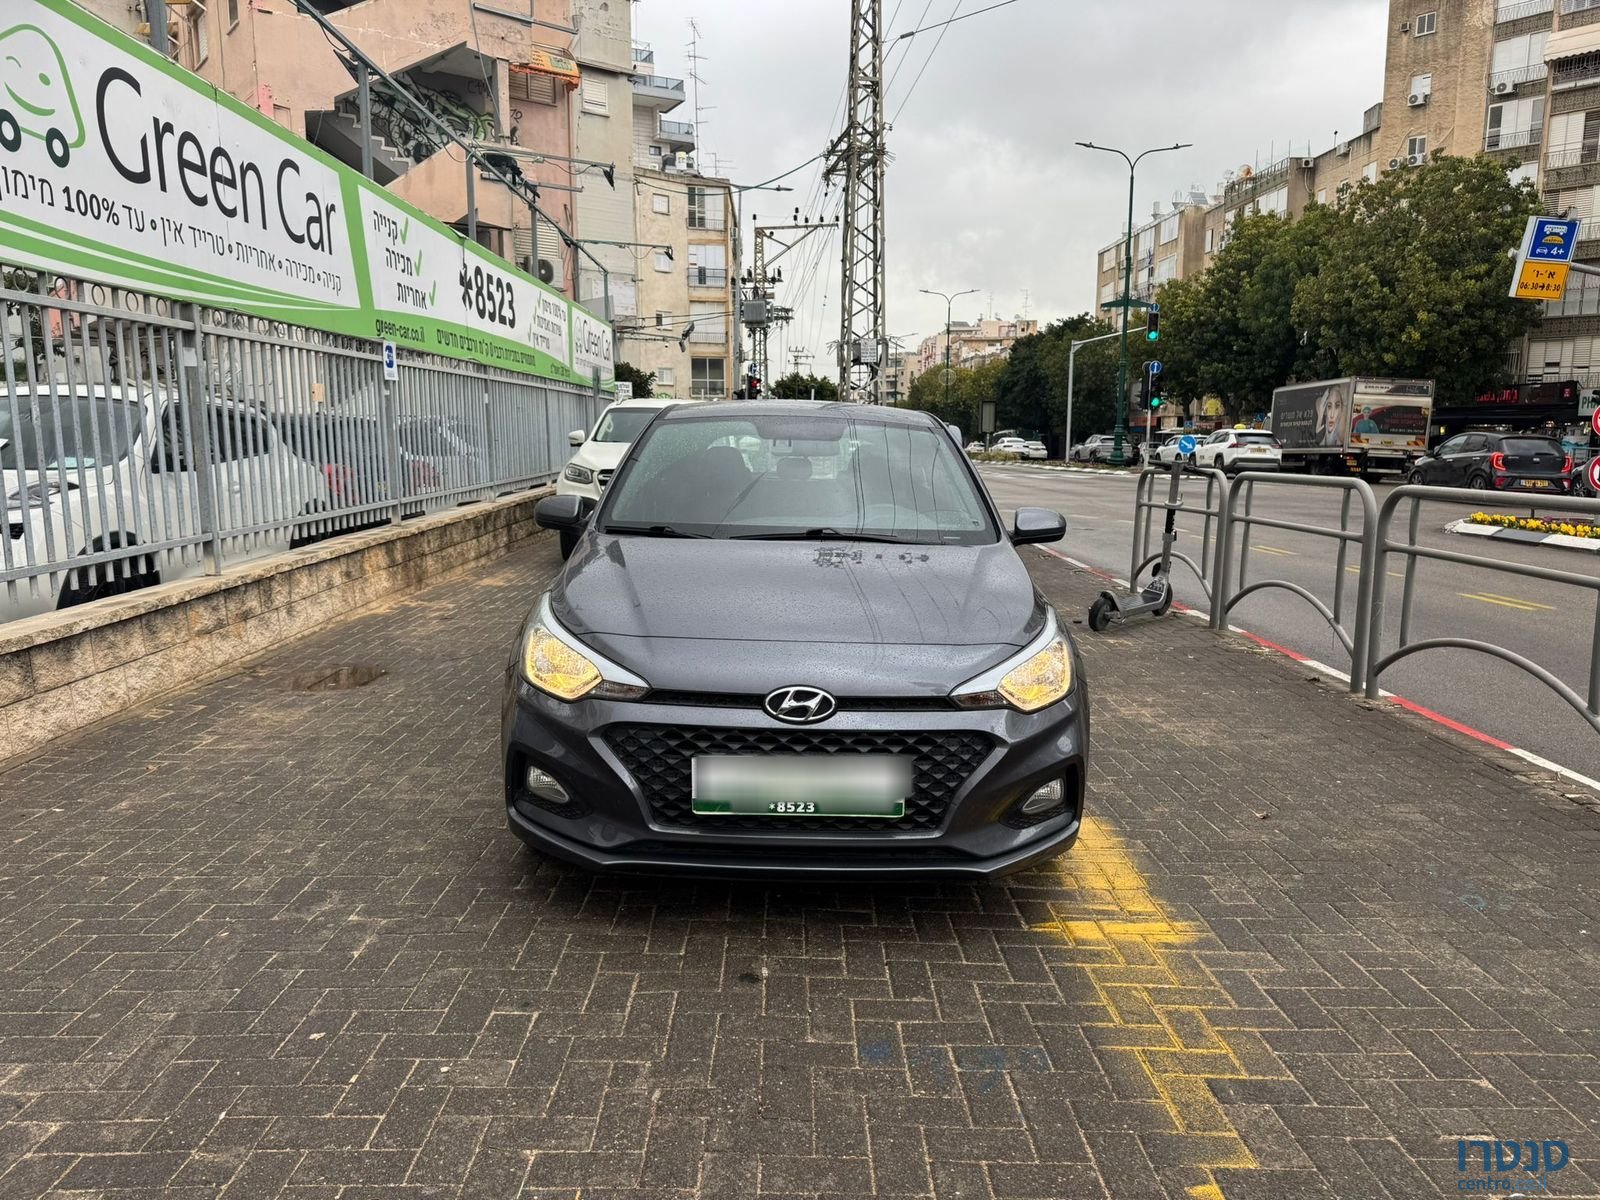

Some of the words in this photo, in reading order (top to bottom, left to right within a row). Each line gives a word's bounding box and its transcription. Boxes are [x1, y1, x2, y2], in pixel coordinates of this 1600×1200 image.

[96, 66, 268, 231] Green
[276, 157, 336, 256] Car
[0, 165, 55, 208] מימו
[62, 185, 120, 226] 100%
[122, 204, 145, 233] עד
[160, 217, 185, 247] אין
[188, 225, 225, 256] טרייד
[373, 210, 398, 245] קנייה
[236, 241, 277, 272] אחריות
[385, 247, 413, 277] מכירה
[1550, 246, 1564, 255] 4+
[285, 258, 315, 284] מכירה
[322, 270, 341, 296] קניה
[396, 282, 428, 310] אחריות
[375, 318, 426, 344] green-car.co.il
